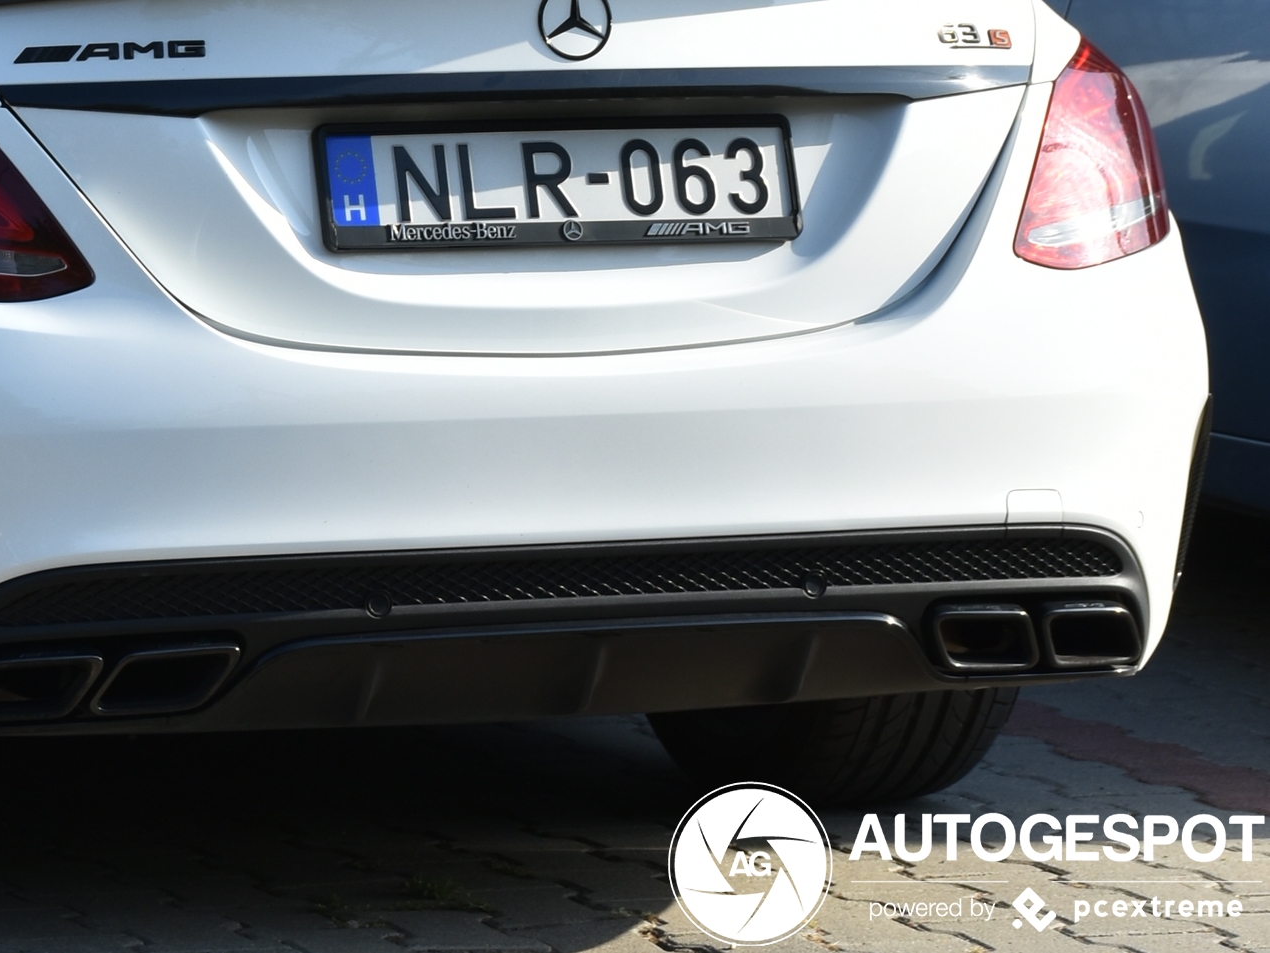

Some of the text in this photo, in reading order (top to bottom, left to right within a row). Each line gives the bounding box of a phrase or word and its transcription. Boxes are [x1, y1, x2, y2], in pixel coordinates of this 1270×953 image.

[937, 23, 980, 44] 63
[76, 40, 206, 61] AMG
[392, 137, 769, 221] NLR-063
[344, 195, 367, 221] H
[390, 222, 517, 241] Mercedes-Benz
[683, 221, 751, 235] AMG
